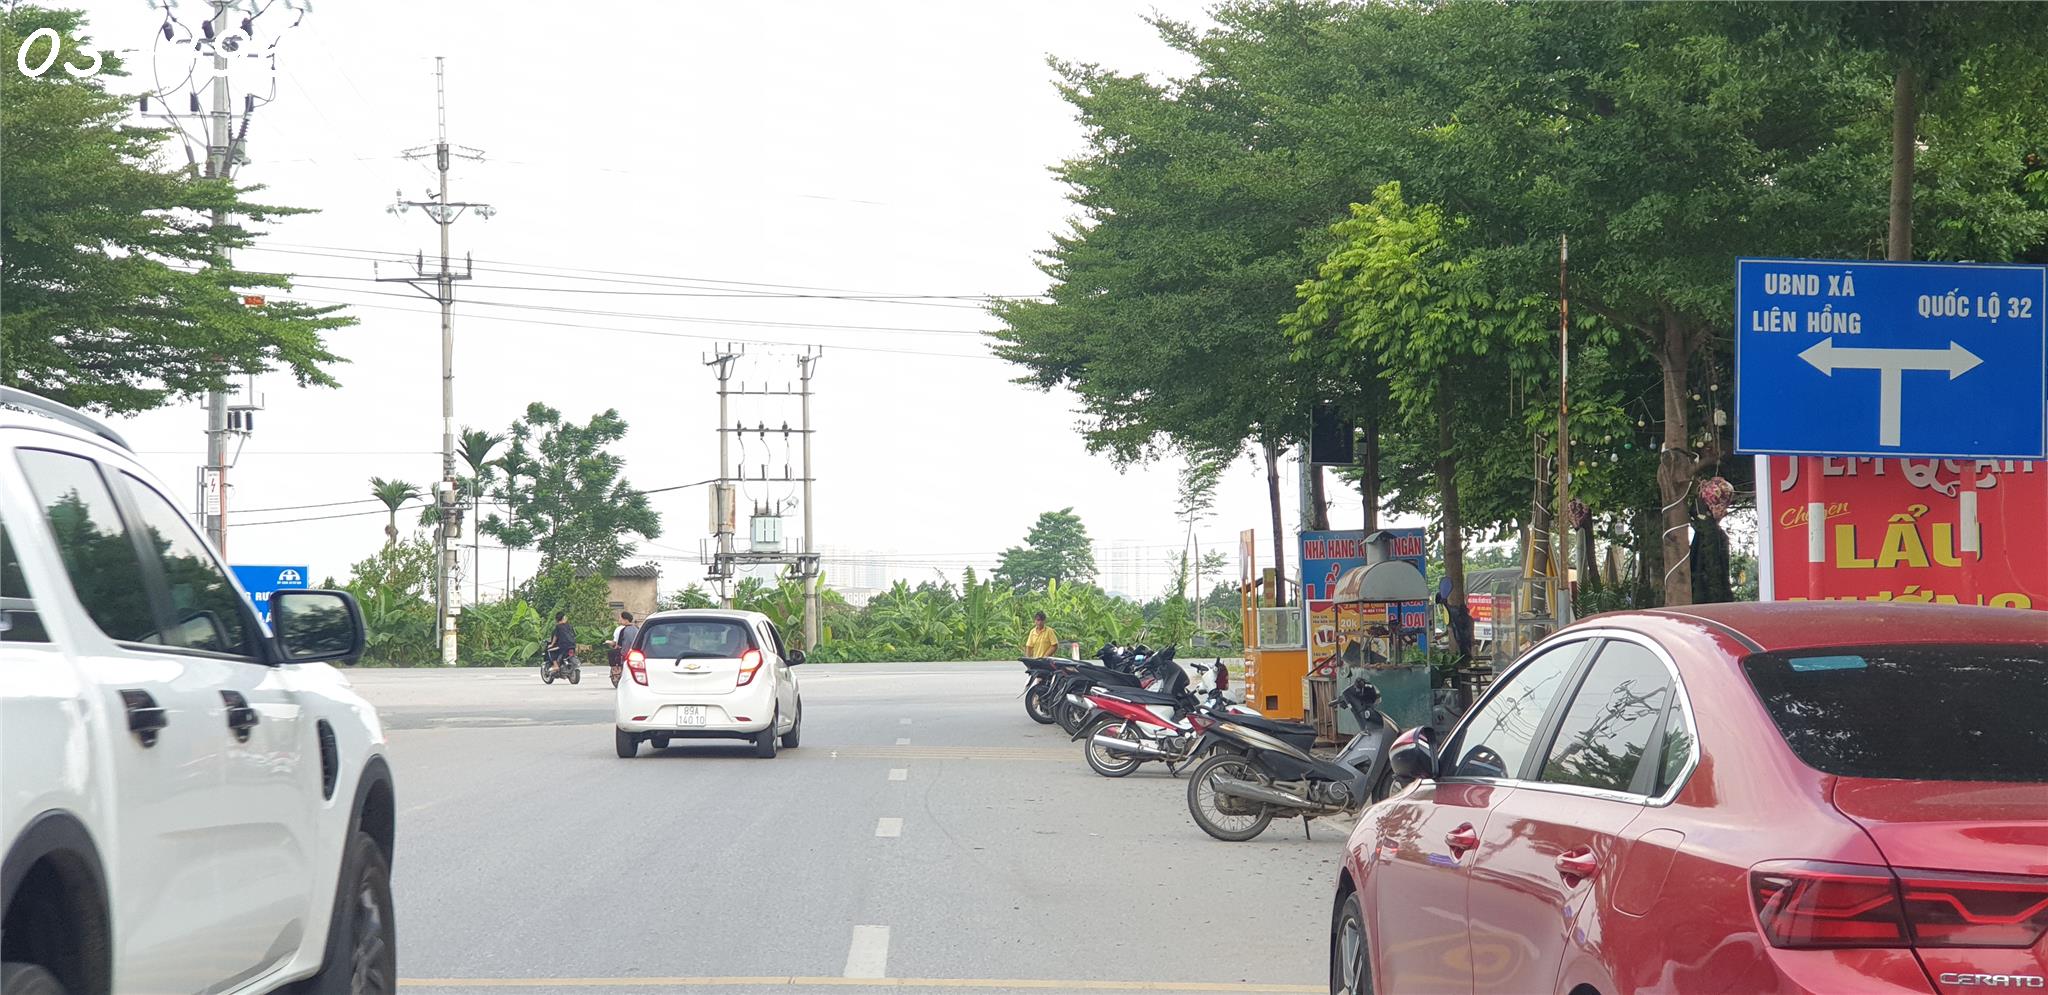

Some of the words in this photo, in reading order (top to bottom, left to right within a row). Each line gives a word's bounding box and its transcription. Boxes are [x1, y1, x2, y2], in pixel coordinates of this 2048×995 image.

[1765, 272, 1820, 296] UBND
[1828, 270, 1855, 297] XÃ
[1753, 306, 1797, 333] LIÊN
[1807, 304, 1861, 334] HỒNG
[1918, 288, 1970, 318] QUỐC
[1977, 291, 2000, 324] LỘ
[2008, 297, 2032, 319] 32
[1304, 535, 1326, 560] NHÀ
[1327, 535, 1355, 559] HÀNG
[1835, 504, 1980, 569] LẨU
[684, 706, 699, 716] 89A
[1940, 972, 2044, 988] CERATO
